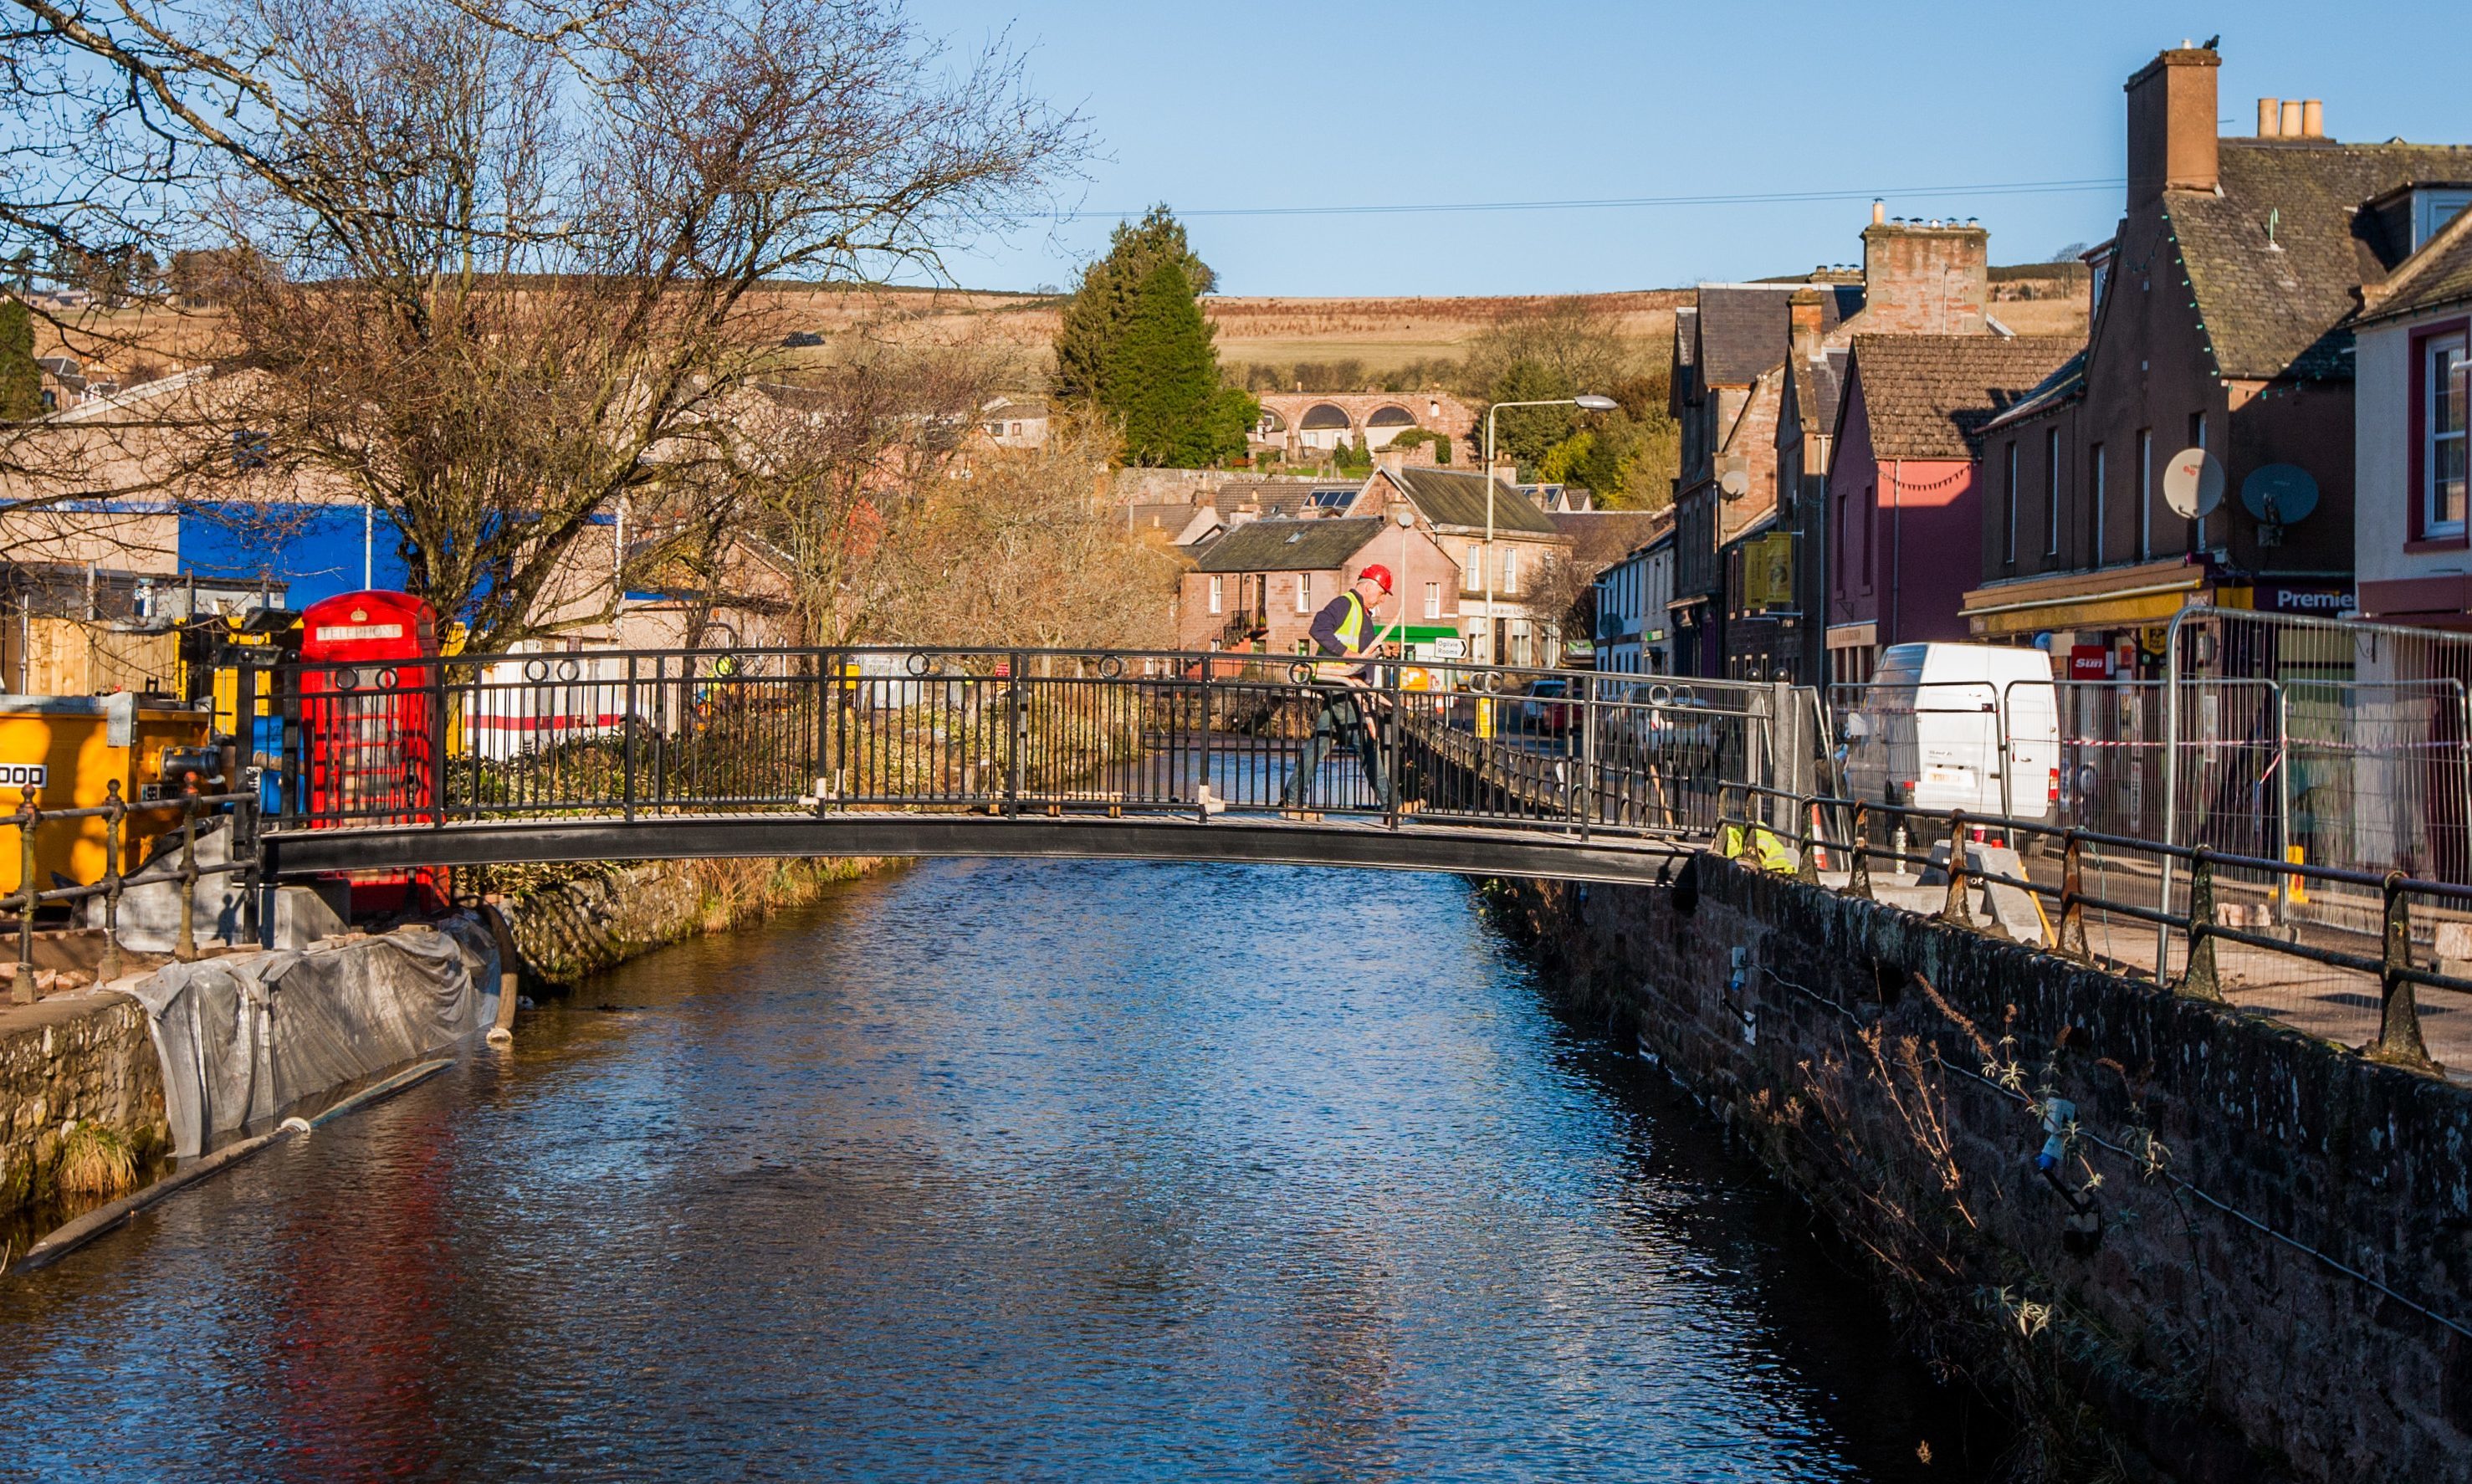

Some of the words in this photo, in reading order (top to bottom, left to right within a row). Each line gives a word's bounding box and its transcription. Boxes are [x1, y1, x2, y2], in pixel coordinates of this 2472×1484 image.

[2278, 589, 2357, 607] Premie
[322, 626, 400, 638] TELEPHONE
[1438, 640, 1458, 648] Ogilvie
[2075, 658, 2103, 668] Sun
